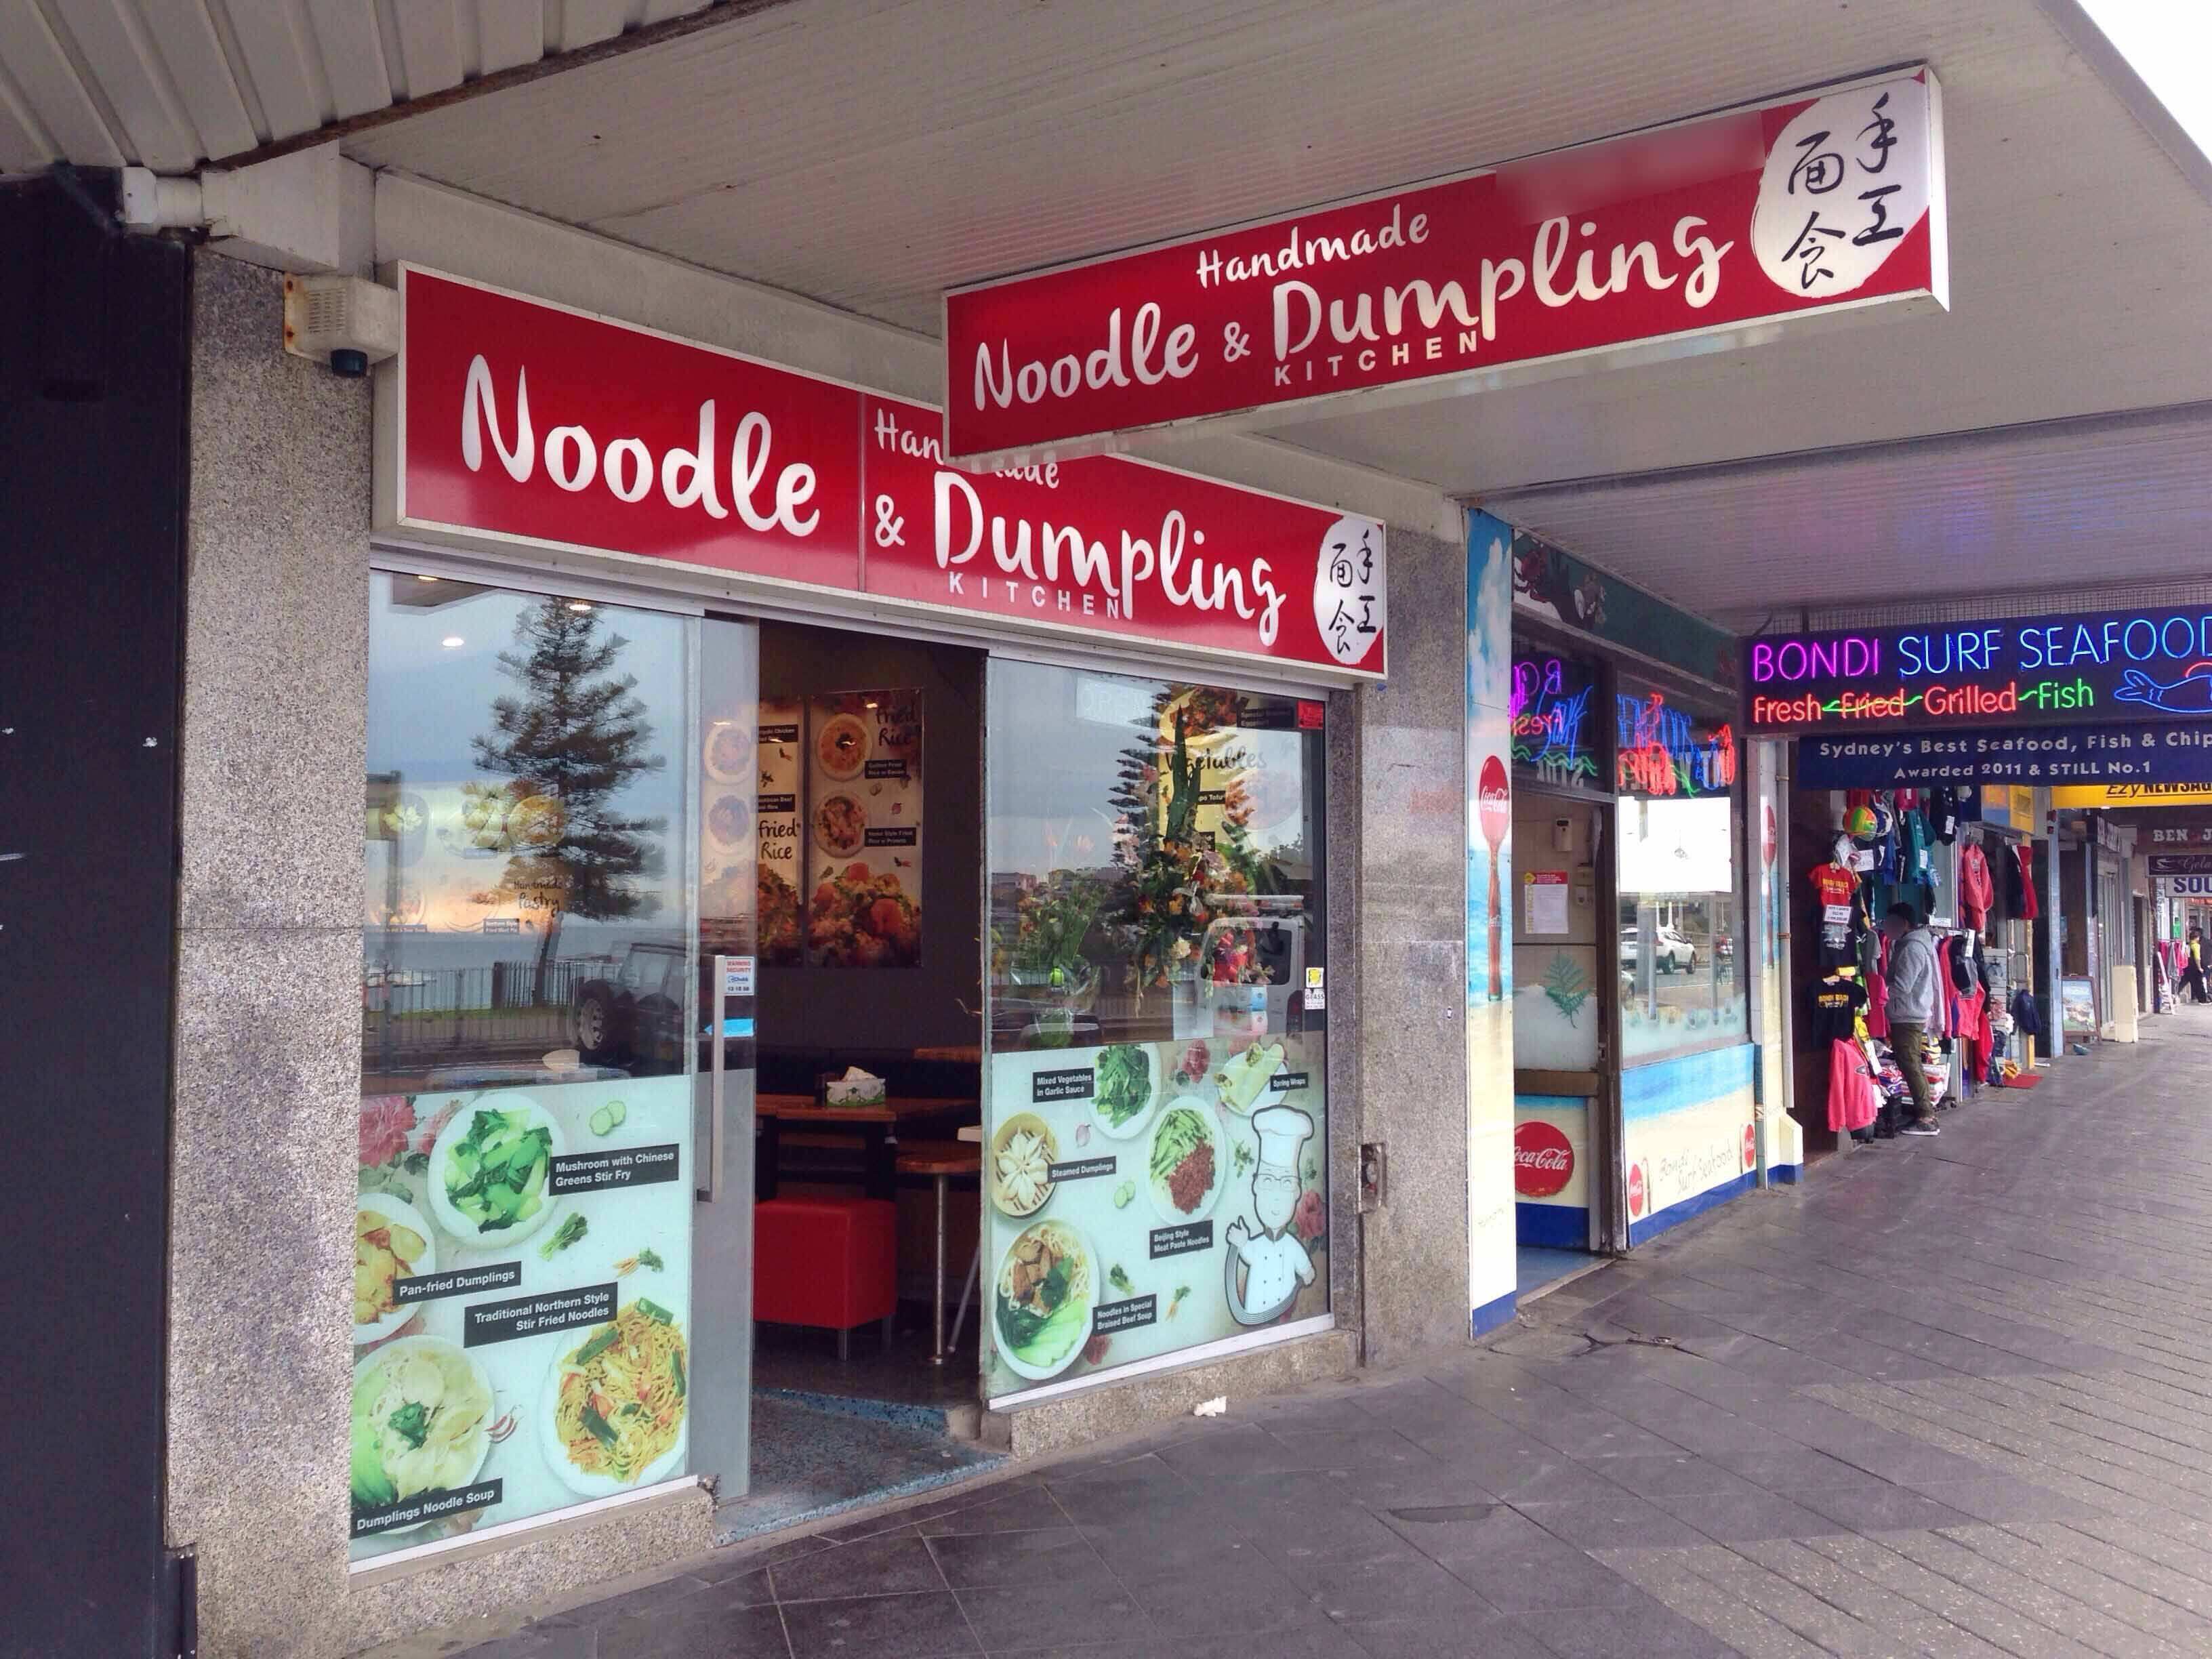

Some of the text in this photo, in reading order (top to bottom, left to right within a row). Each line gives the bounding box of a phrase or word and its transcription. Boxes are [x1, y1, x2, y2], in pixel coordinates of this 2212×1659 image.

[1197, 203, 1429, 288] Handmade
[974, 215, 1734, 411] Noodle & Dumpling
[1275, 330, 1477, 386] KITCHEN
[461, 354, 1287, 647] Noodle & Dumpling
[950, 573, 1120, 619] KITCHEN
[1753, 638, 1880, 682] BONDI
[1898, 629, 2001, 676] SURF
[1754, 678, 2094, 724] Fresh Fried Grilled Fish
[1820, 741, 1912, 758] Sydney's
[1921, 740, 1967, 754] Best
[1977, 735, 2077, 753] Seafood,
[2087, 734, 2132, 750] Fish
[2142, 733, 2156, 747] &
[1894, 760, 2152, 779] Awarded 2011 & STILL No.1
[2152, 829, 2189, 842] BEN
[761, 841, 793, 860] Rice
[518, 891, 560, 918] Pastry
[1037, 1073, 1092, 1086] Mixed Vegetables
[1045, 1086, 1064, 1096] Garlic
[1065, 1086, 1085, 1094] Sauce
[556, 1152, 674, 1173] Mushroom with Chinese
[1052, 1166, 1080, 1178] Steamed
[556, 1169, 632, 1187] Greens Stir Fry
[399, 1269, 516, 1296] Pan-fried Dumplings
[475, 1292, 610, 1324] Traditional Northern Style
[516, 1306, 610, 1332] Stir Fried Noodles
[1097, 1308, 1122, 1319] Noodles
[1130, 1300, 1153, 1313] Special
[1122, 1314, 1136, 1324] Beef
[1137, 1312, 1153, 1322] Soup
[356, 1489, 495, 1531] Dumplings Noodle Soup
